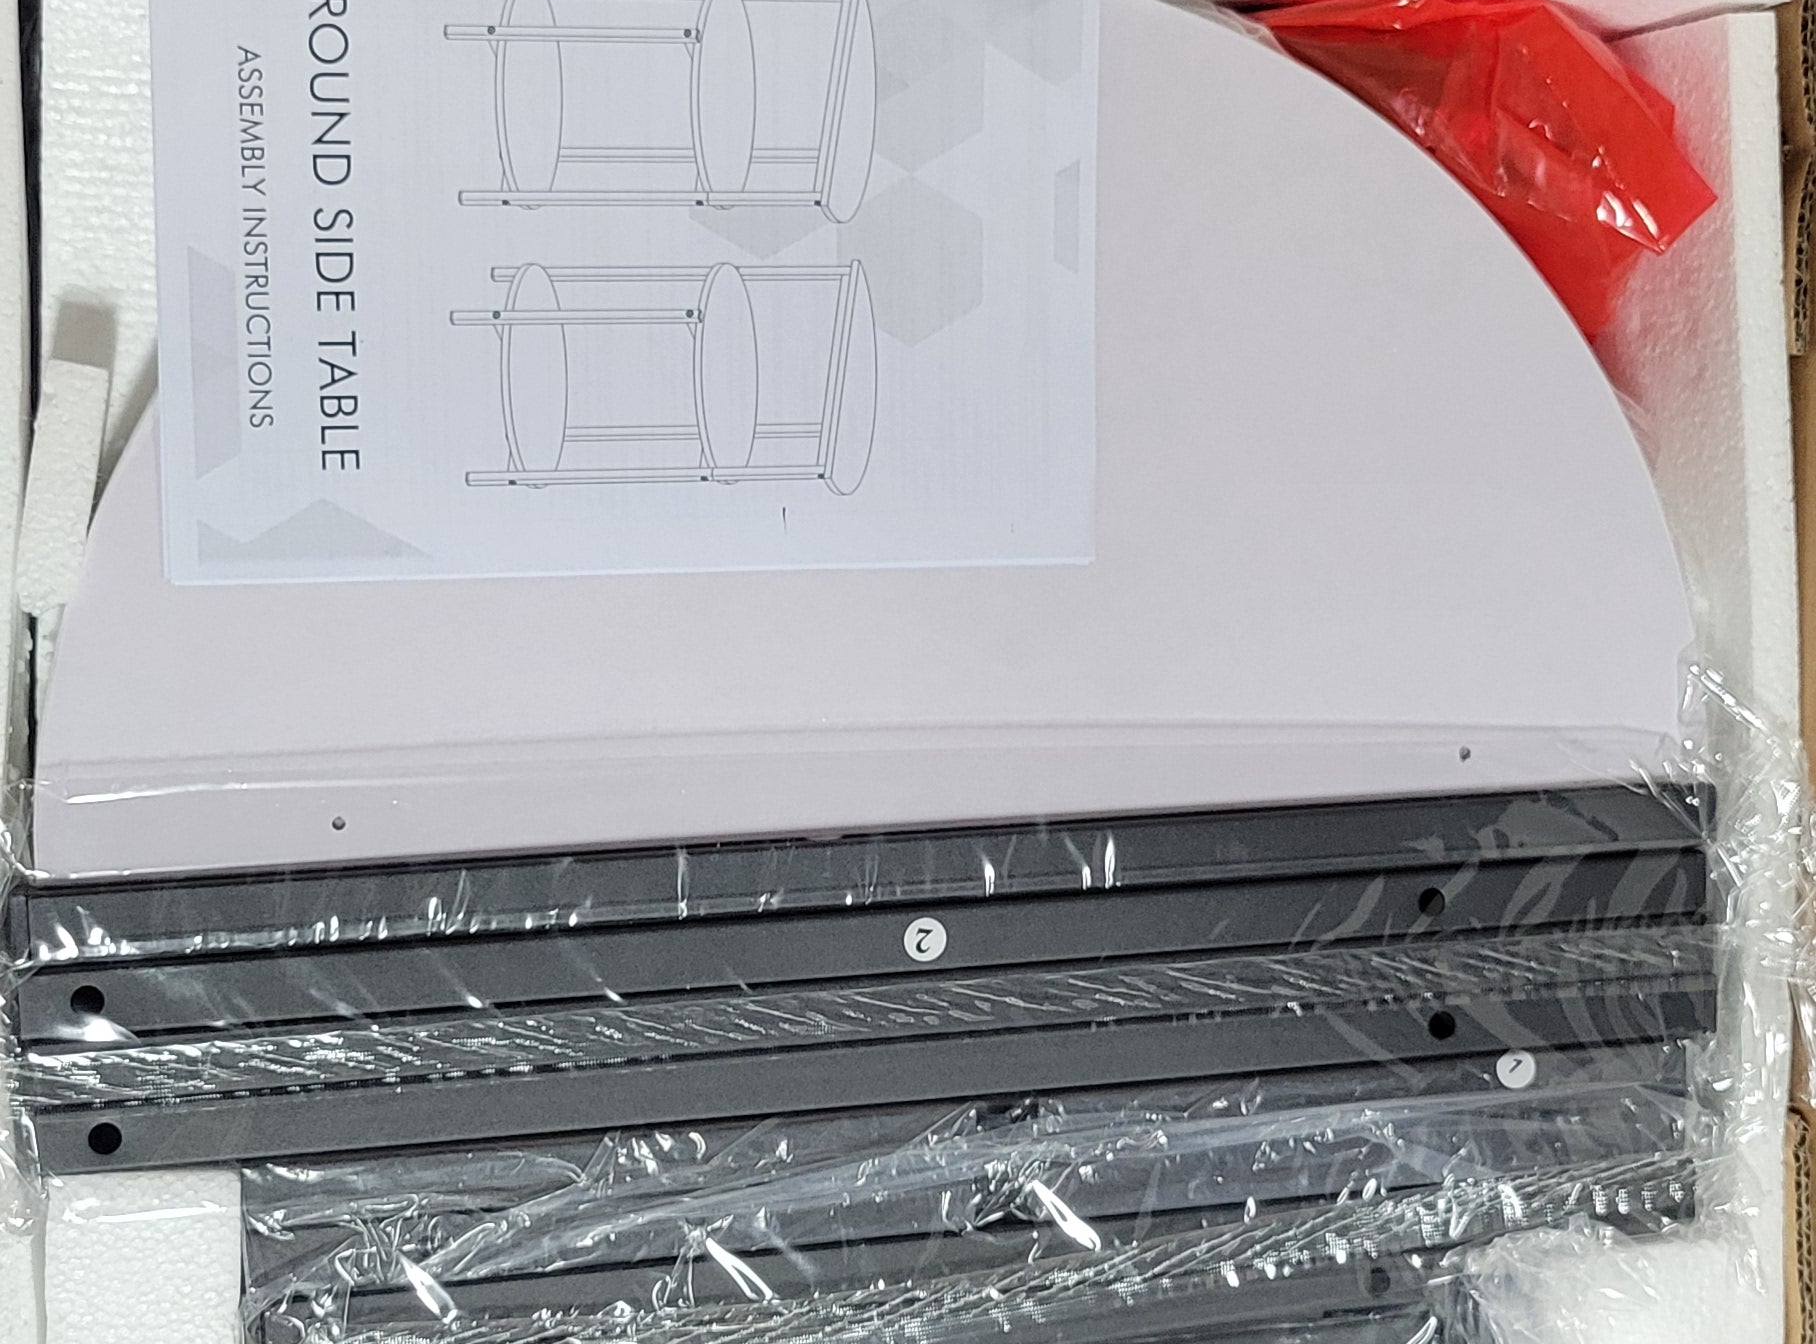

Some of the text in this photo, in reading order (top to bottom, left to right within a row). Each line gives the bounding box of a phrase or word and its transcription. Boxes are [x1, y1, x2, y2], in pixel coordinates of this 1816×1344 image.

[237, 45, 275, 428] ASSEMBLY INSTRUCTIONS
[313, 207, 356, 312] SIDE
[317, 330, 360, 471] TABLE
[916, 927, 934, 954] 2
